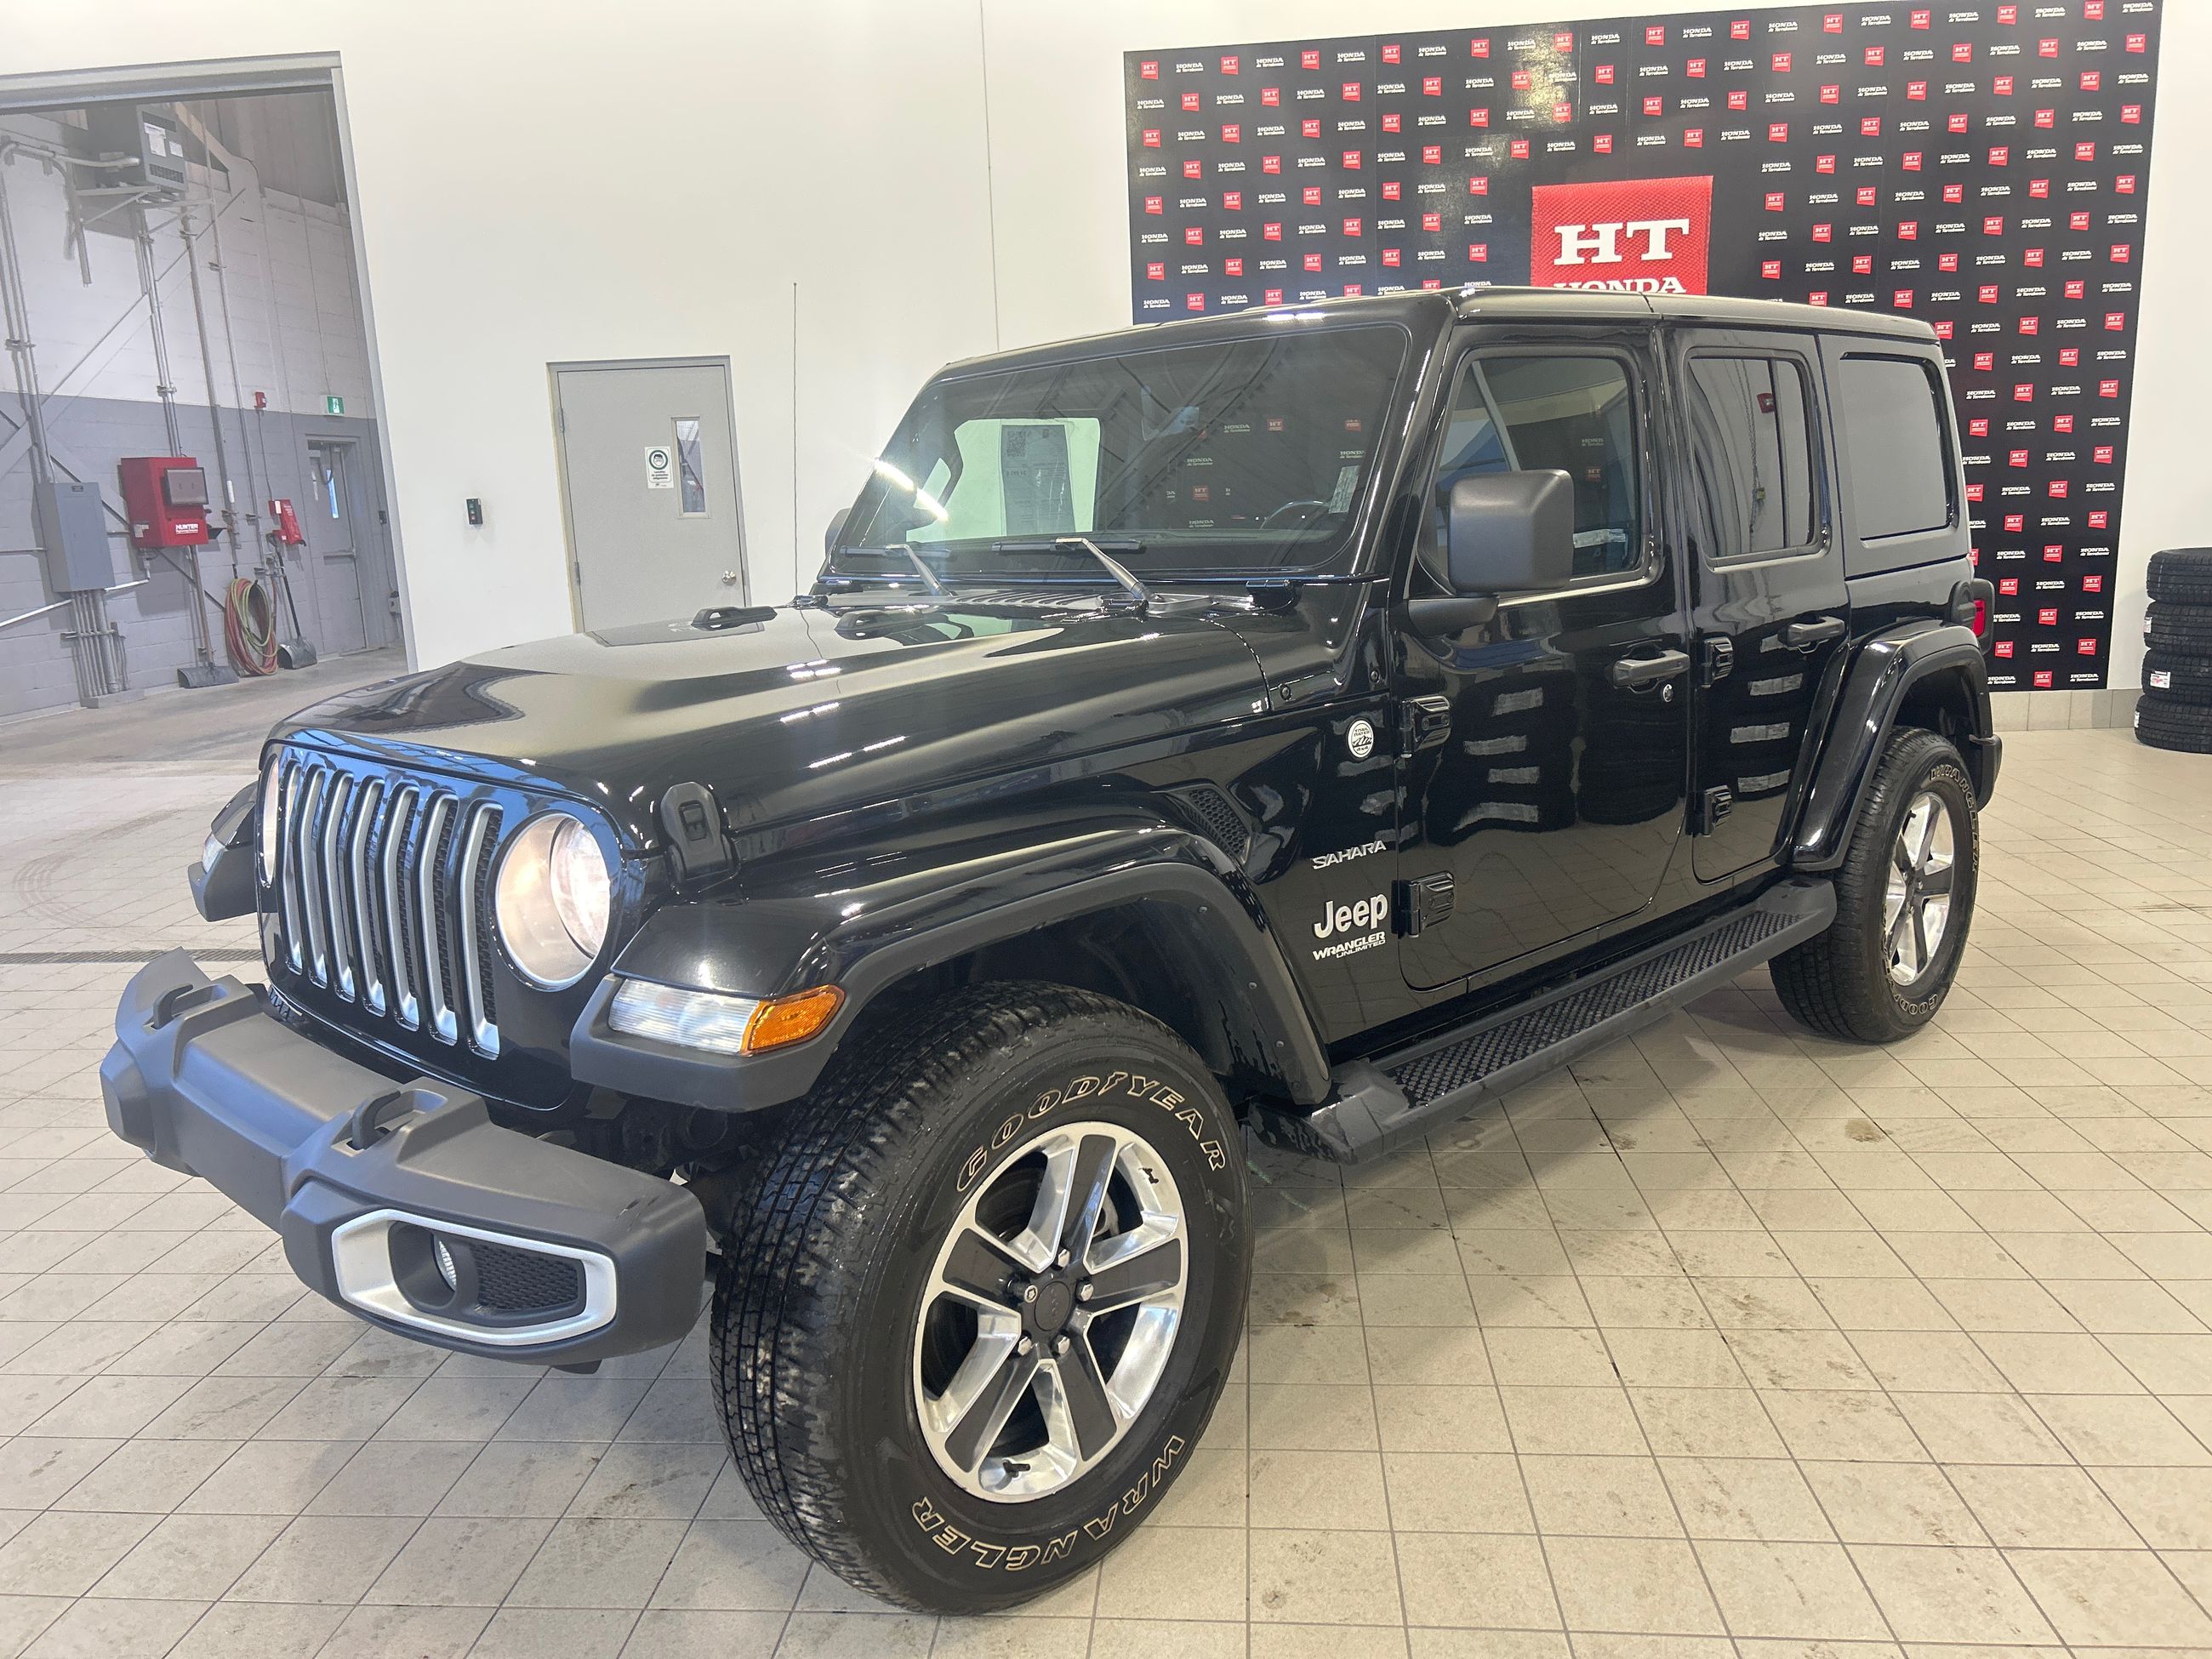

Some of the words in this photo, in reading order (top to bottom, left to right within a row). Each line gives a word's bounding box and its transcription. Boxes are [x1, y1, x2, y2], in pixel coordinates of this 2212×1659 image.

[1554, 218, 1690, 265] HT
[175, 523, 199, 532] HUNTER
[1930, 764, 1980, 873] WRANGLER
[1311, 840, 1387, 869] SAHARA
[1313, 893, 1388, 939] Jeep
[1313, 931, 1386, 961] WRANGLER
[1336, 939, 1386, 959] UNLIMITED
[956, 1071, 1227, 1192] GOODYEAR
[911, 1434, 1186, 1571] WRANGLER
